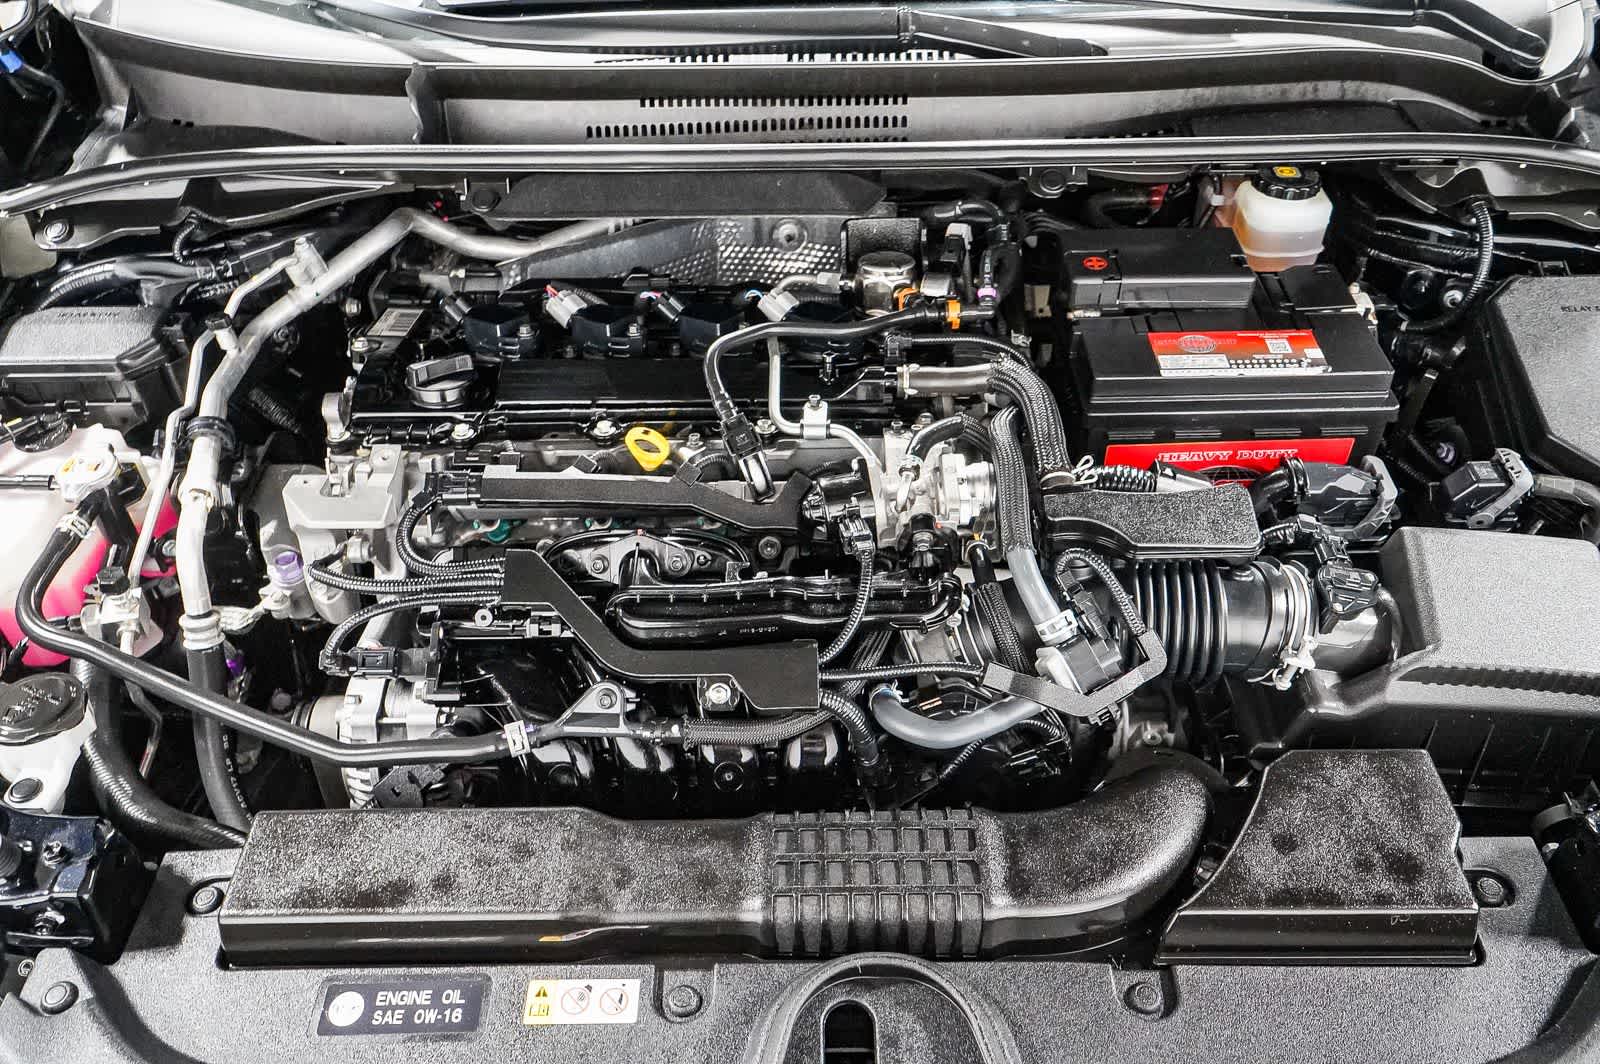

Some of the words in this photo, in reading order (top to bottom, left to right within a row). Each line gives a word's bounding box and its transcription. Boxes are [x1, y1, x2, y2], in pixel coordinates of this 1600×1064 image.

[1158, 450, 1233, 463] HEAVY
[1236, 449, 1299, 460] DUTY
[375, 990, 433, 1006] ENGINE
[441, 989, 466, 1005] OIL
[371, 1009, 405, 1025] SAE
[413, 1007, 463, 1024] 0W-16
